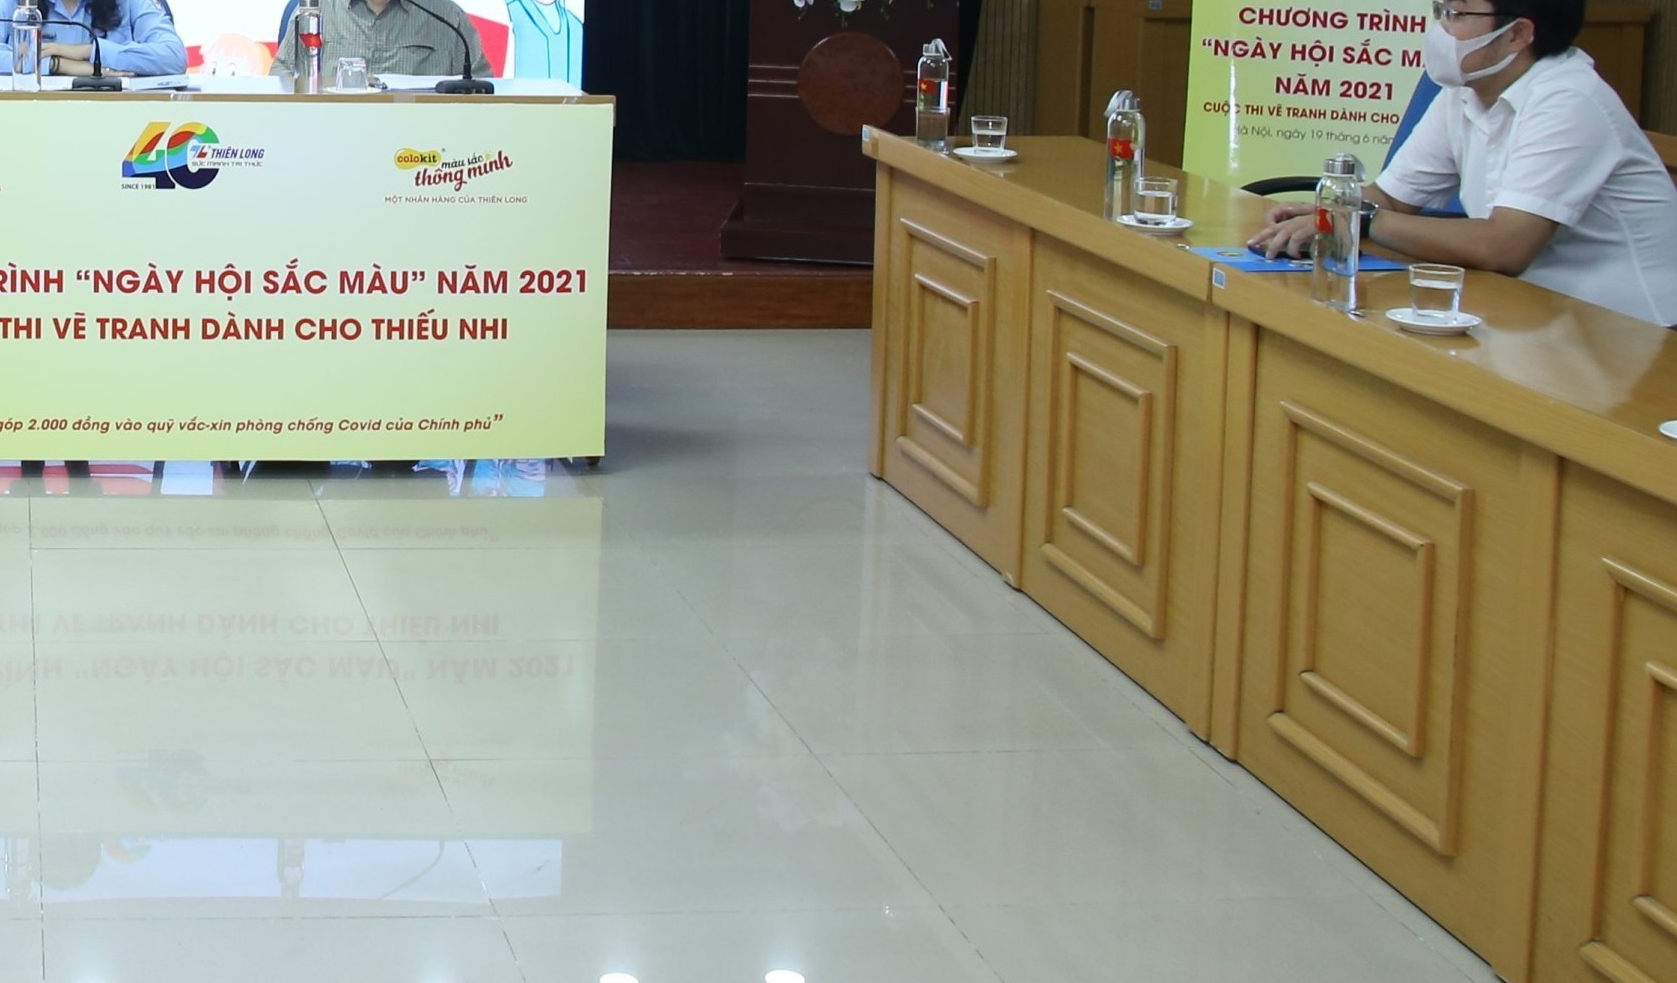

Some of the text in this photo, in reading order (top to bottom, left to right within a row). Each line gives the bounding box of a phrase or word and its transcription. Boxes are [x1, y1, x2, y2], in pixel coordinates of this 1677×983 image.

[1239, 6, 1426, 33] CHƯƠNG TRÌNH
[1290, 40, 1334, 66] HỘI
[1342, 39, 1392, 65] SẮC
[1275, 73, 1393, 100] NĂM 2021
[1245, 104, 1263, 116] THI
[1286, 107, 1326, 120] TRANH
[1331, 107, 1366, 122] DÀNH
[1371, 112, 1400, 124] CHO
[211, 146, 265, 159] THIÊN LONG
[397, 154, 437, 163] colokit
[415, 168, 467, 191] thông
[196, 263, 251, 301] HỘI
[263, 258, 327, 294] SẮC
[438, 264, 507, 294] NĂM
[520, 270, 585, 293] 2021
[0, 318, 41, 339] THI
[53, 311, 86, 339] VẼ
[96, 318, 190, 339] TRANH
[202, 312, 283, 340] DÀNH
[295, 318, 361, 340] CHO
[371, 309, 448, 340] THIẾU
[460, 318, 507, 339] NHI
[28, 419, 68, 430] 2.000
[72, 416, 110, 434] đồng
[116, 419, 142, 430] vào
[236, 419, 283, 434] phòng
[288, 417, 333, 434] chống
[339, 420, 381, 430] Covid
[386, 418, 413, 430] của
[418, 418, 459, 430] Chính
